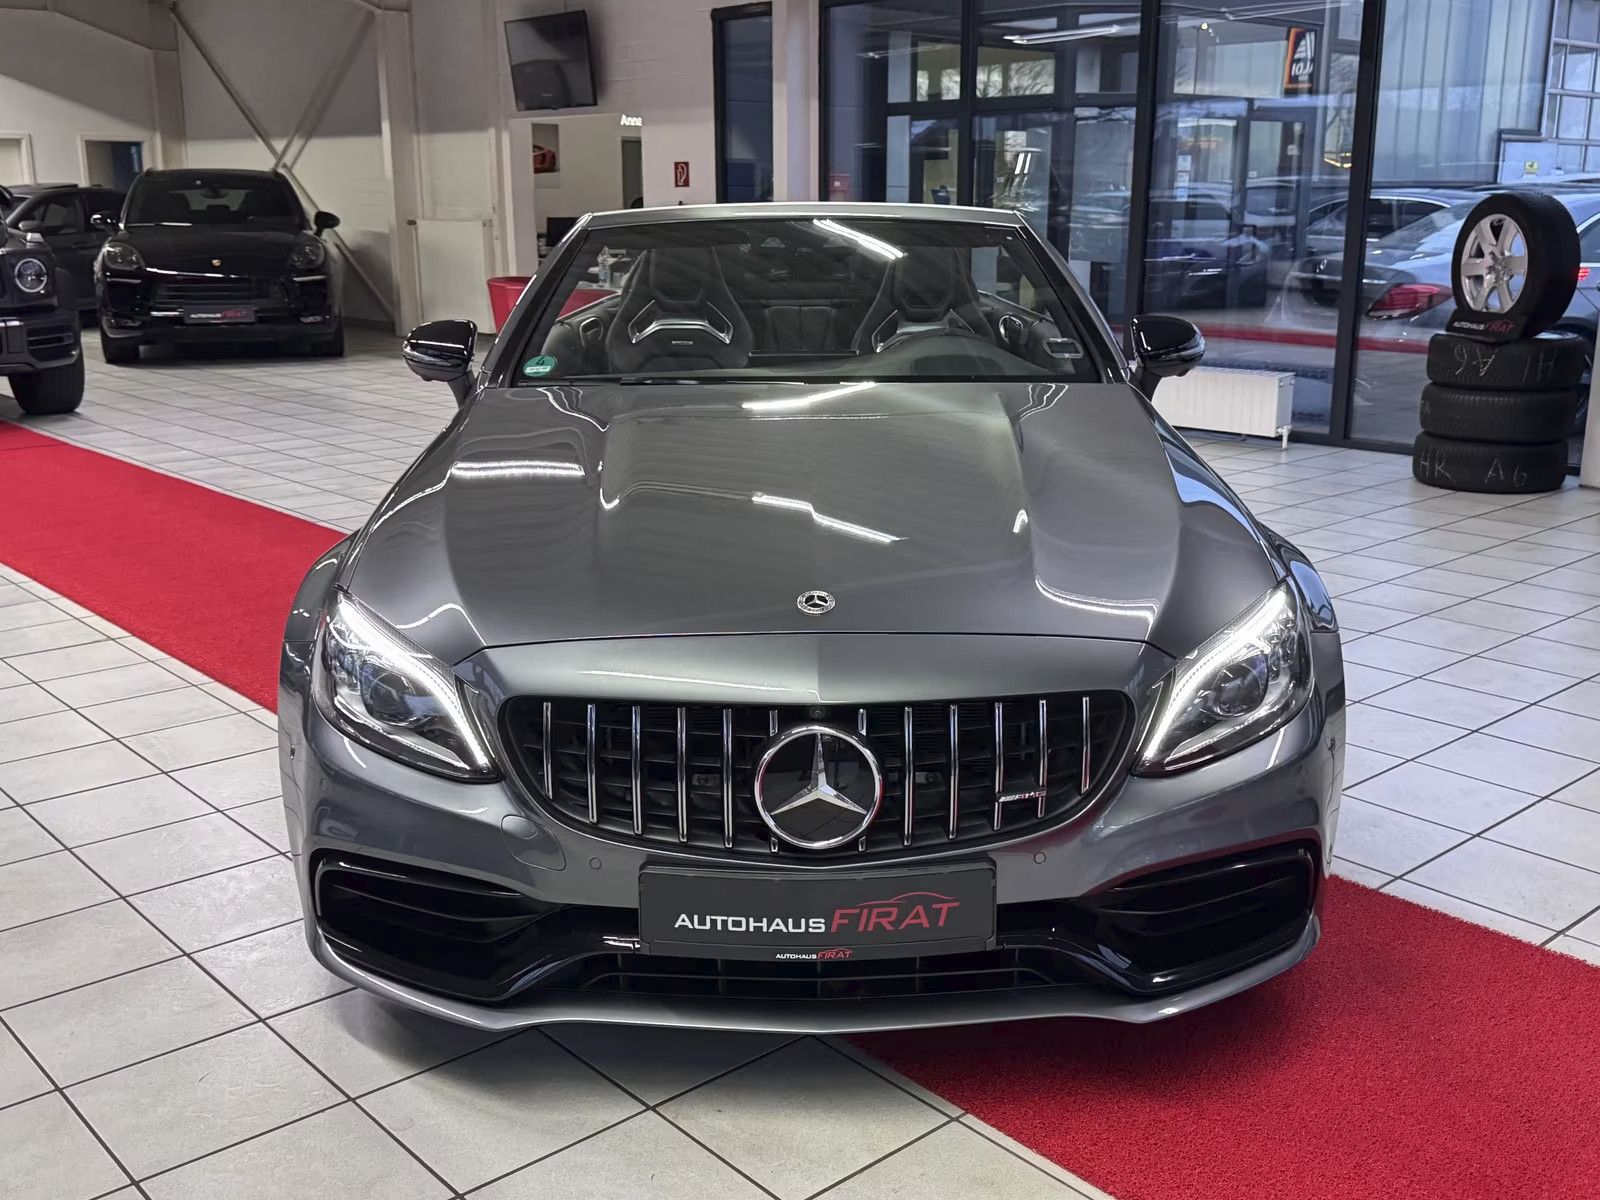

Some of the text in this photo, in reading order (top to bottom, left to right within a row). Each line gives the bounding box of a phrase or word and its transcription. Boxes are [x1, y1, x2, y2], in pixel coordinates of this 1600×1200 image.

[674, 900, 961, 934] AUTOHAUS FIRAT
[817, 950, 853, 960] FIRAT
